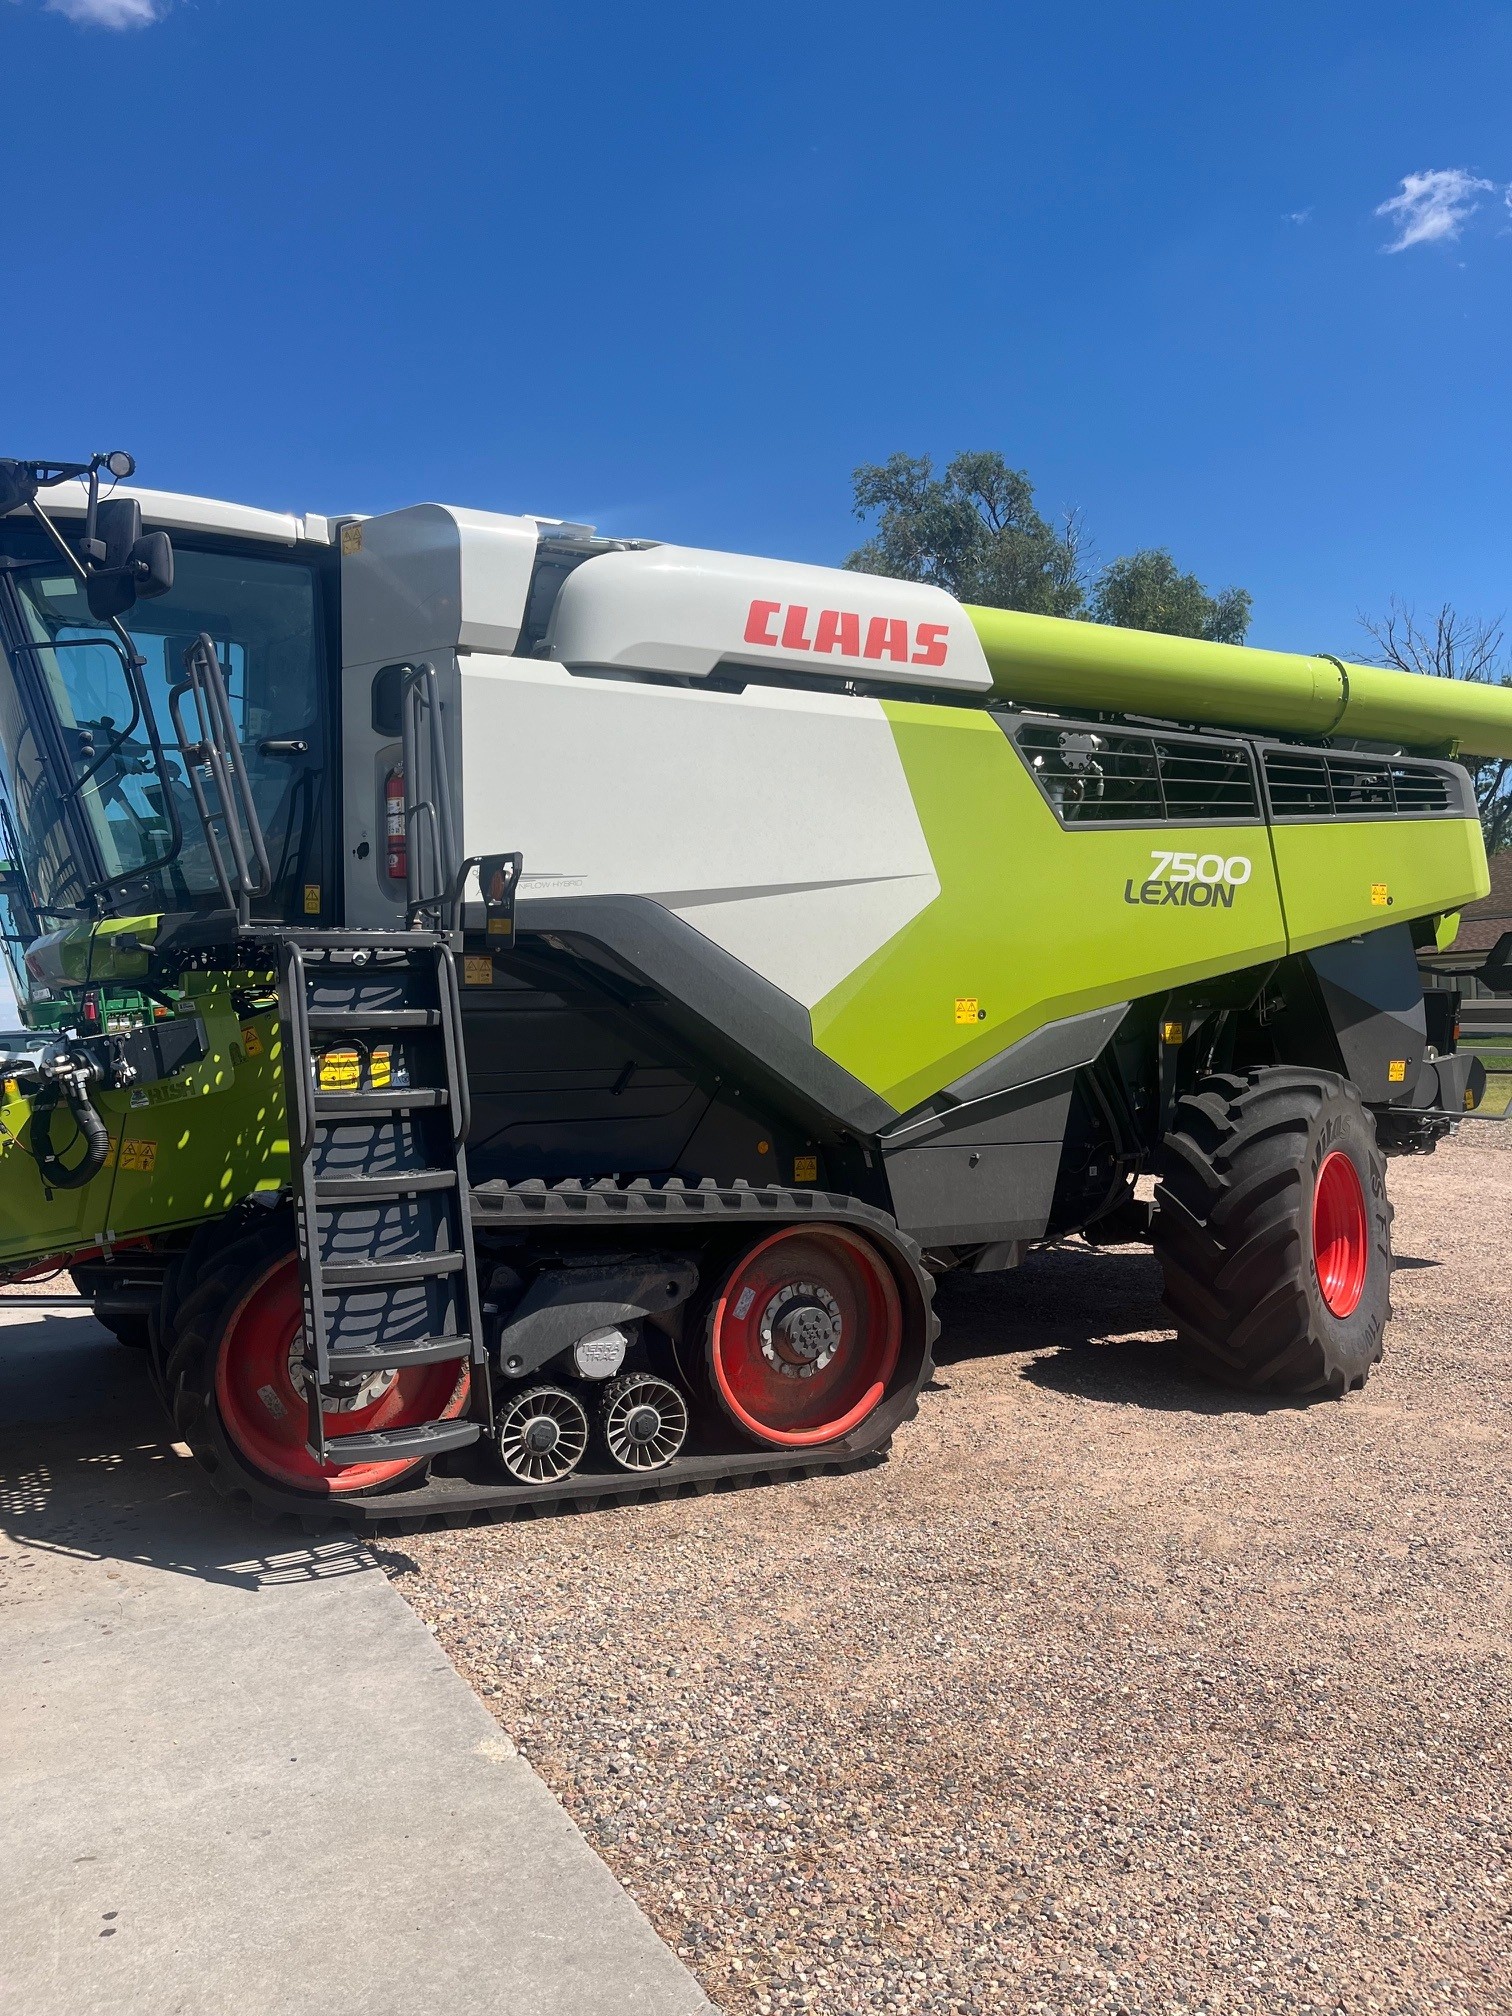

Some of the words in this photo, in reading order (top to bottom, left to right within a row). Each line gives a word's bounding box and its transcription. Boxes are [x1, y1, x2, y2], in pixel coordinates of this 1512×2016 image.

[744, 600, 949, 666] CLAAS
[1147, 850, 1252, 885] 7500
[552, 880, 583, 888] HYBRID
[1124, 879, 1236, 908] LEXION
[582, 1341, 620, 1354] TERRA
[586, 1351, 617, 1362] TRAC
